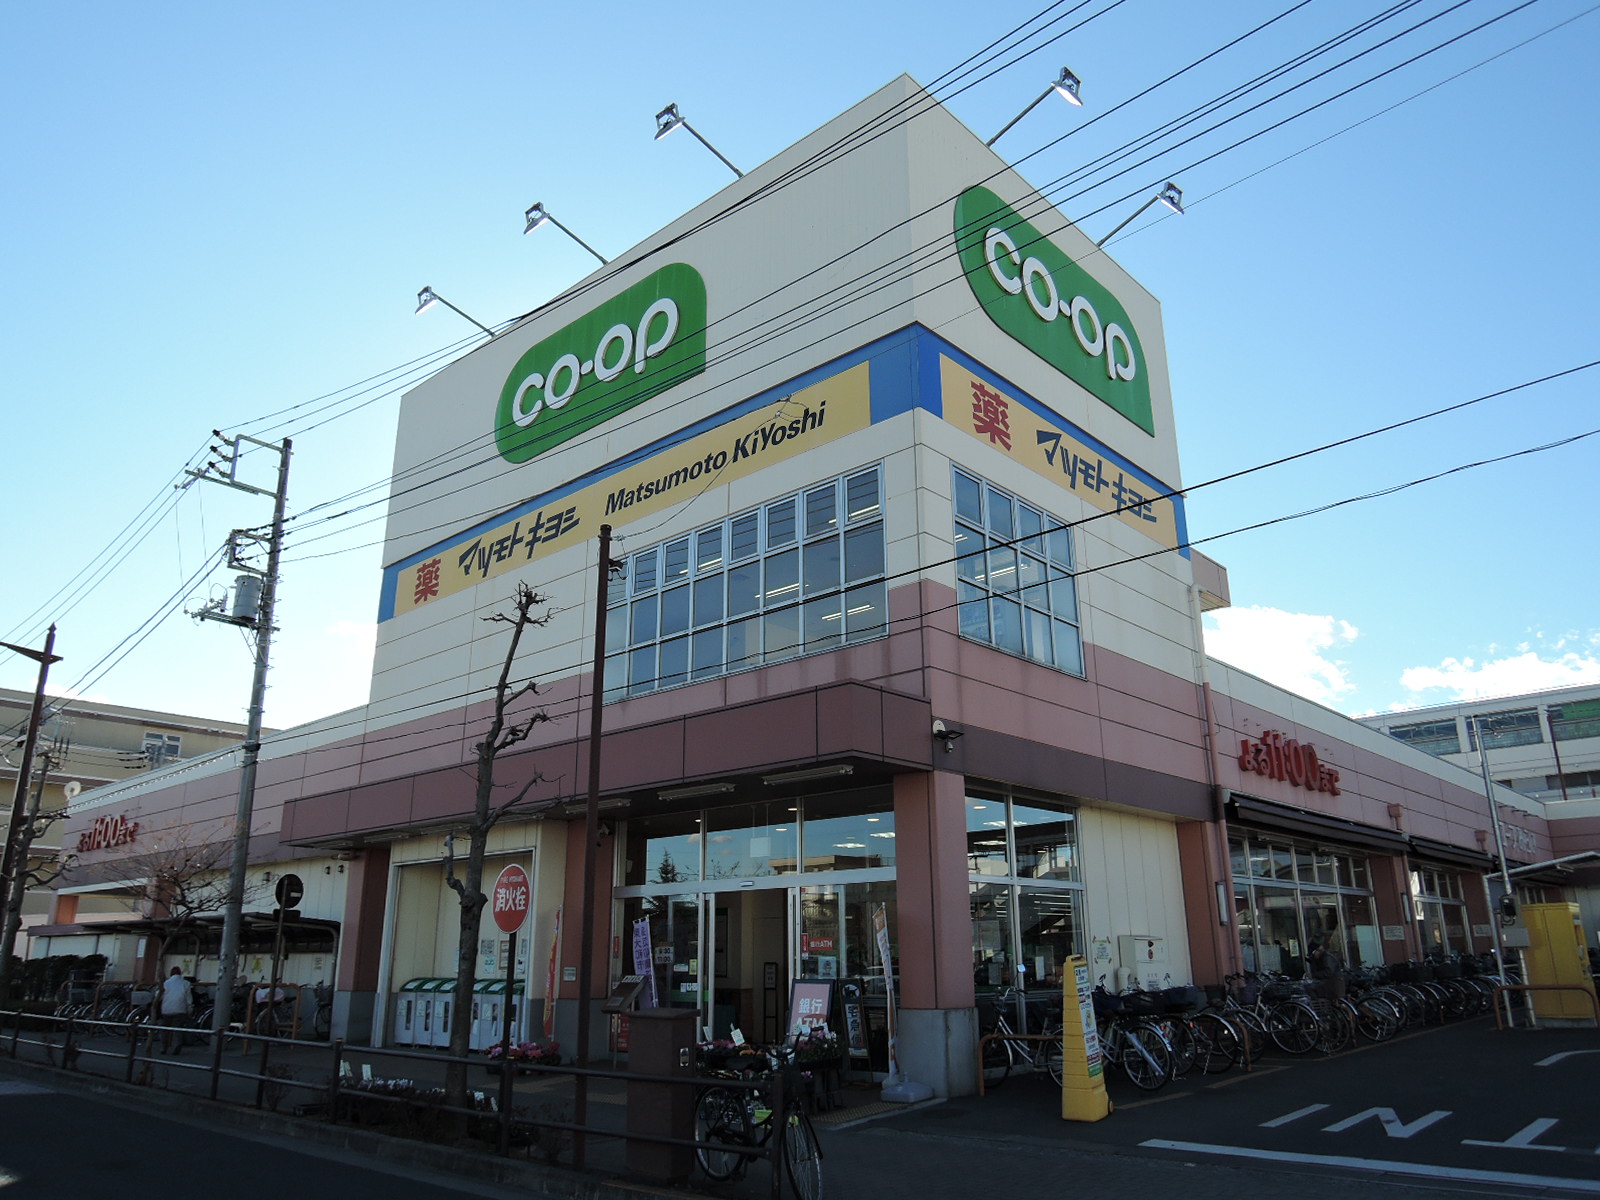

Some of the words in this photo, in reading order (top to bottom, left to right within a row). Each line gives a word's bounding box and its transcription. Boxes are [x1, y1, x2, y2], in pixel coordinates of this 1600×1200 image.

[604, 451, 727, 515] Matsumoto
[970, 381, 1012, 451] 薬
[1036, 430, 1157, 523] マツモトキヨシ
[414, 558, 442, 604] 薬
[458, 506, 581, 579] マツモトキヨシ
[495, 886, 526, 912] 消火栓
[798, 998, 823, 1014] 銀行
